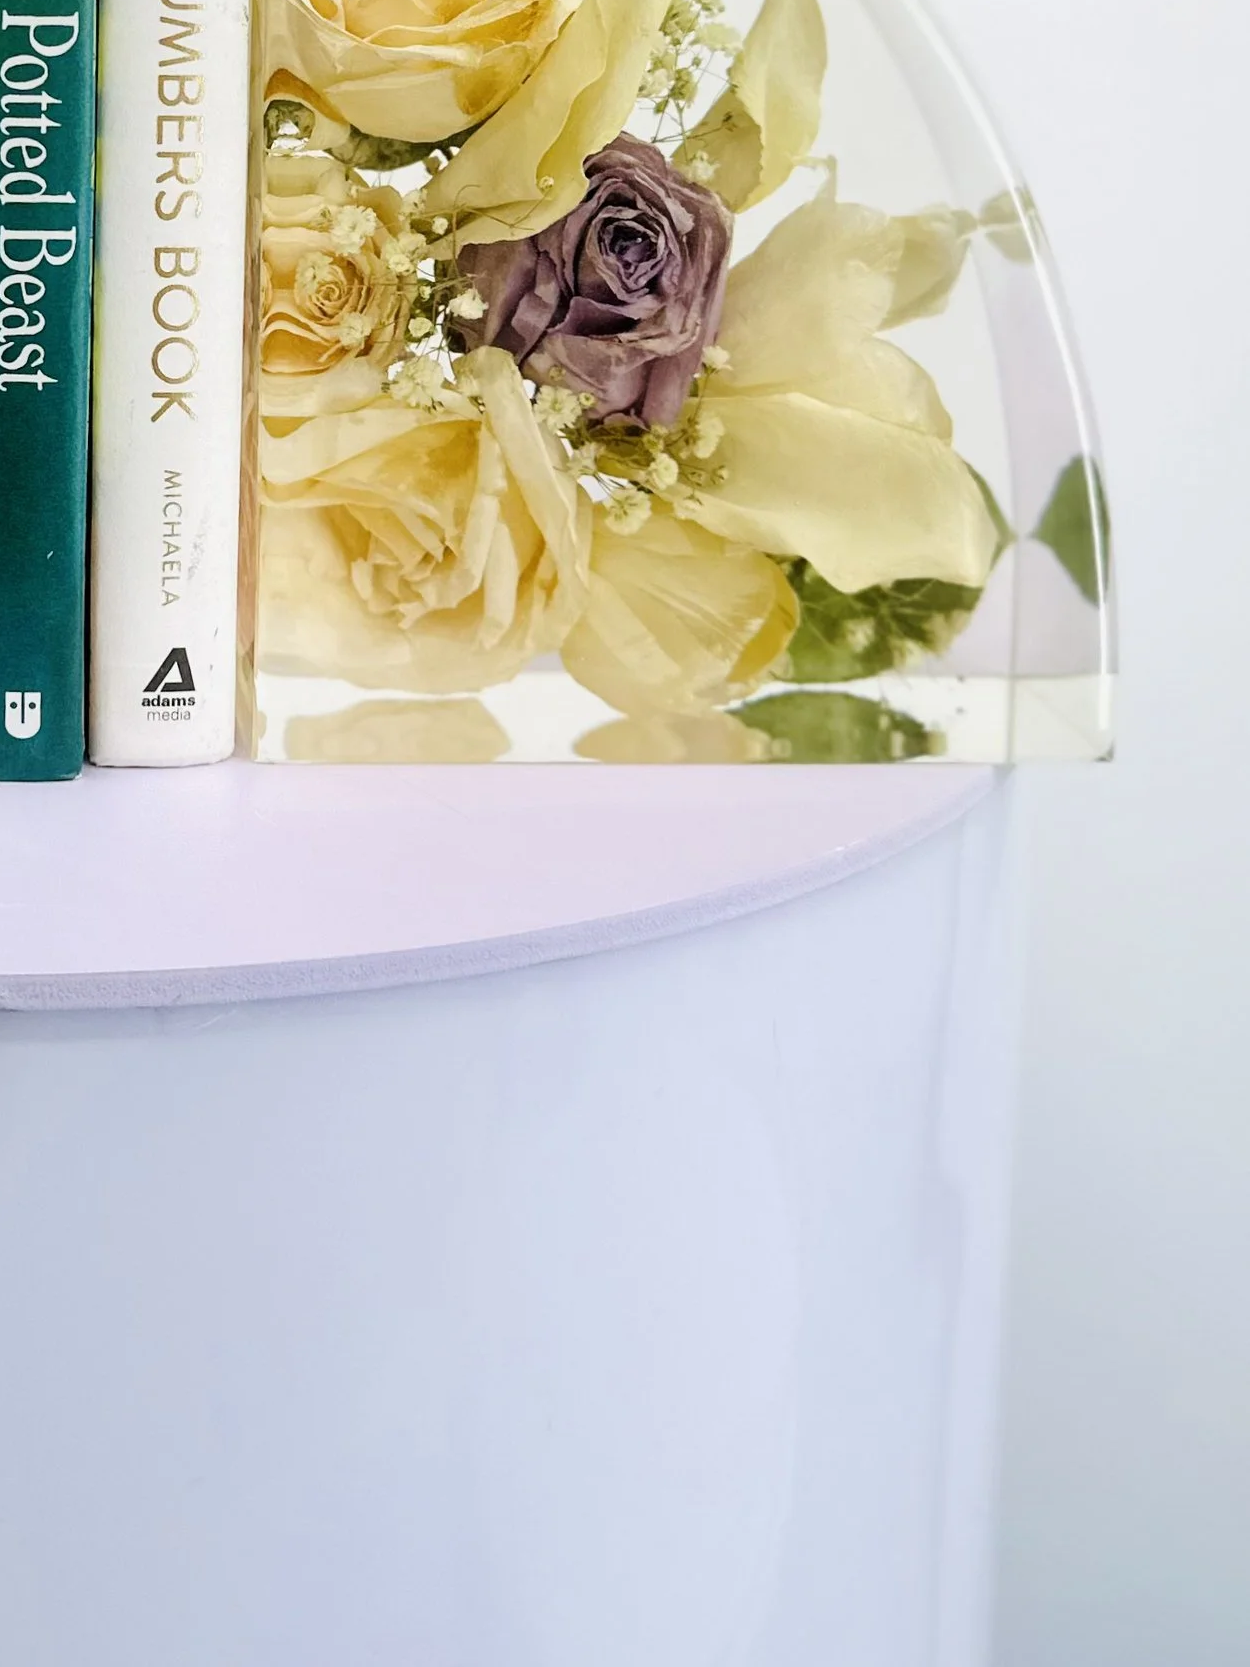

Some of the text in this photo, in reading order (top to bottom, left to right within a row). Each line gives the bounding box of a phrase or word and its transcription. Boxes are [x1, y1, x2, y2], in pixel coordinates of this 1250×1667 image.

[150, 245, 201, 422] BOOK
[162, 469, 183, 607] MICHAELA
[141, 695, 196, 707] adams
[146, 708, 192, 721] media
